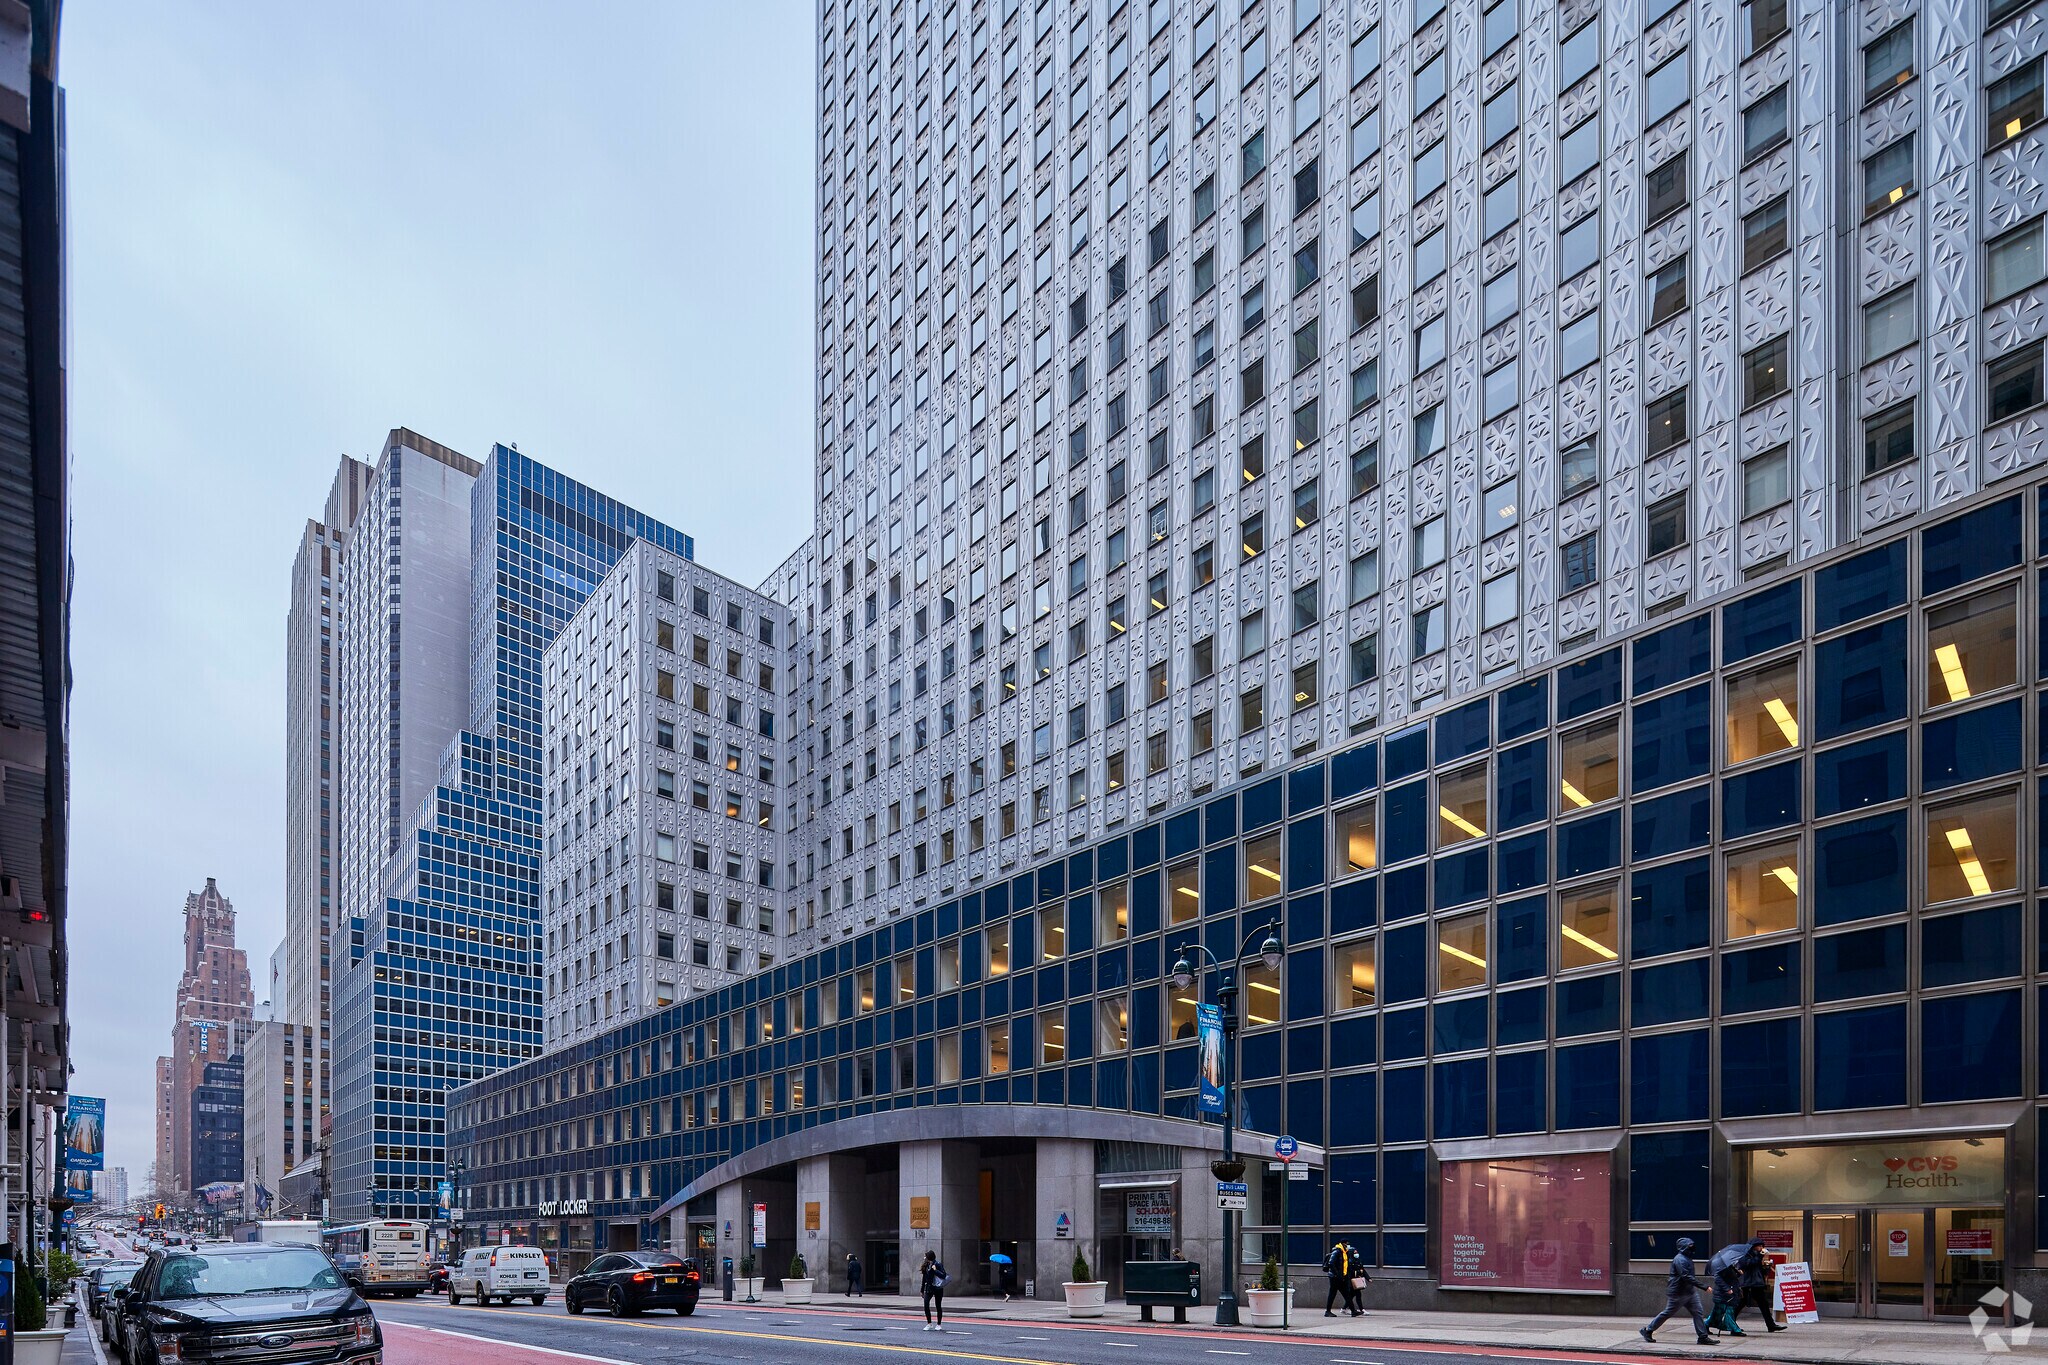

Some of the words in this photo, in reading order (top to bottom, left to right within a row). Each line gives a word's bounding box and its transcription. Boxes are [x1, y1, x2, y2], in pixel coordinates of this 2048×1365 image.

[1907, 1156, 1958, 1172] CVS
[1886, 1173, 1958, 1188] Health
[539, 1201, 557, 1216] FOOT
[560, 1200, 588, 1215] LOCKER
[1454, 1242, 1484, 1250] working
[1454, 1270, 1498, 1278] community.
